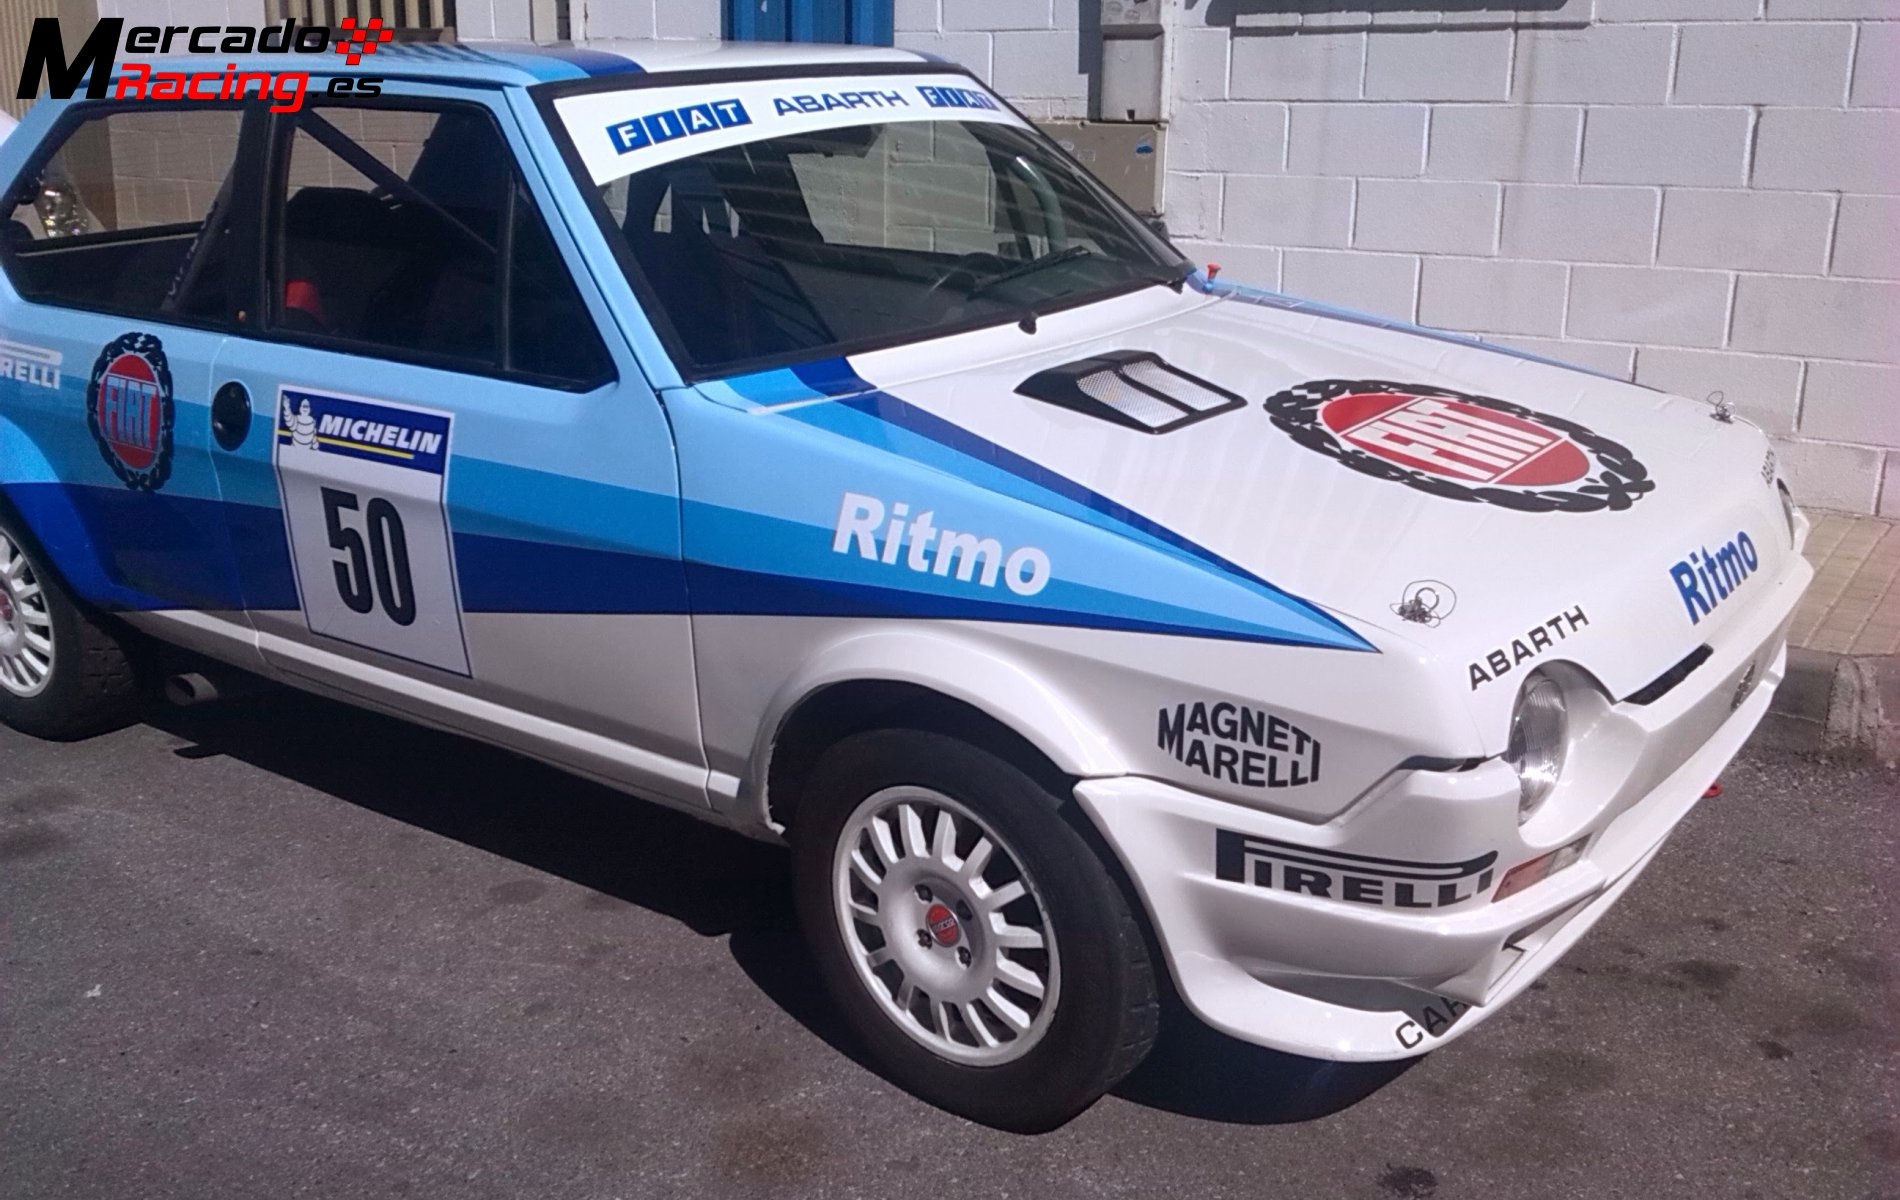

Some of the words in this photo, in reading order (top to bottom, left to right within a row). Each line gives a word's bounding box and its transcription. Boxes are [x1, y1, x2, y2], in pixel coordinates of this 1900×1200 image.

[608, 99, 750, 153] FIAT
[774, 90, 909, 117] ABARTH
[917, 87, 998, 110] FIAT
[105, 374, 158, 447] FIAT
[319, 413, 442, 455] MICHELIN
[1345, 399, 1553, 481] FIAT
[320, 486, 416, 627] 50
[833, 492, 1051, 596] Ritmo
[1669, 531, 1758, 625] Ritmo
[1467, 604, 1590, 691] ABARTH
[1157, 701, 1321, 770] MAGNETI
[1157, 728, 1321, 788] MARELLI
[1216, 828, 1499, 909] PIRELLI
